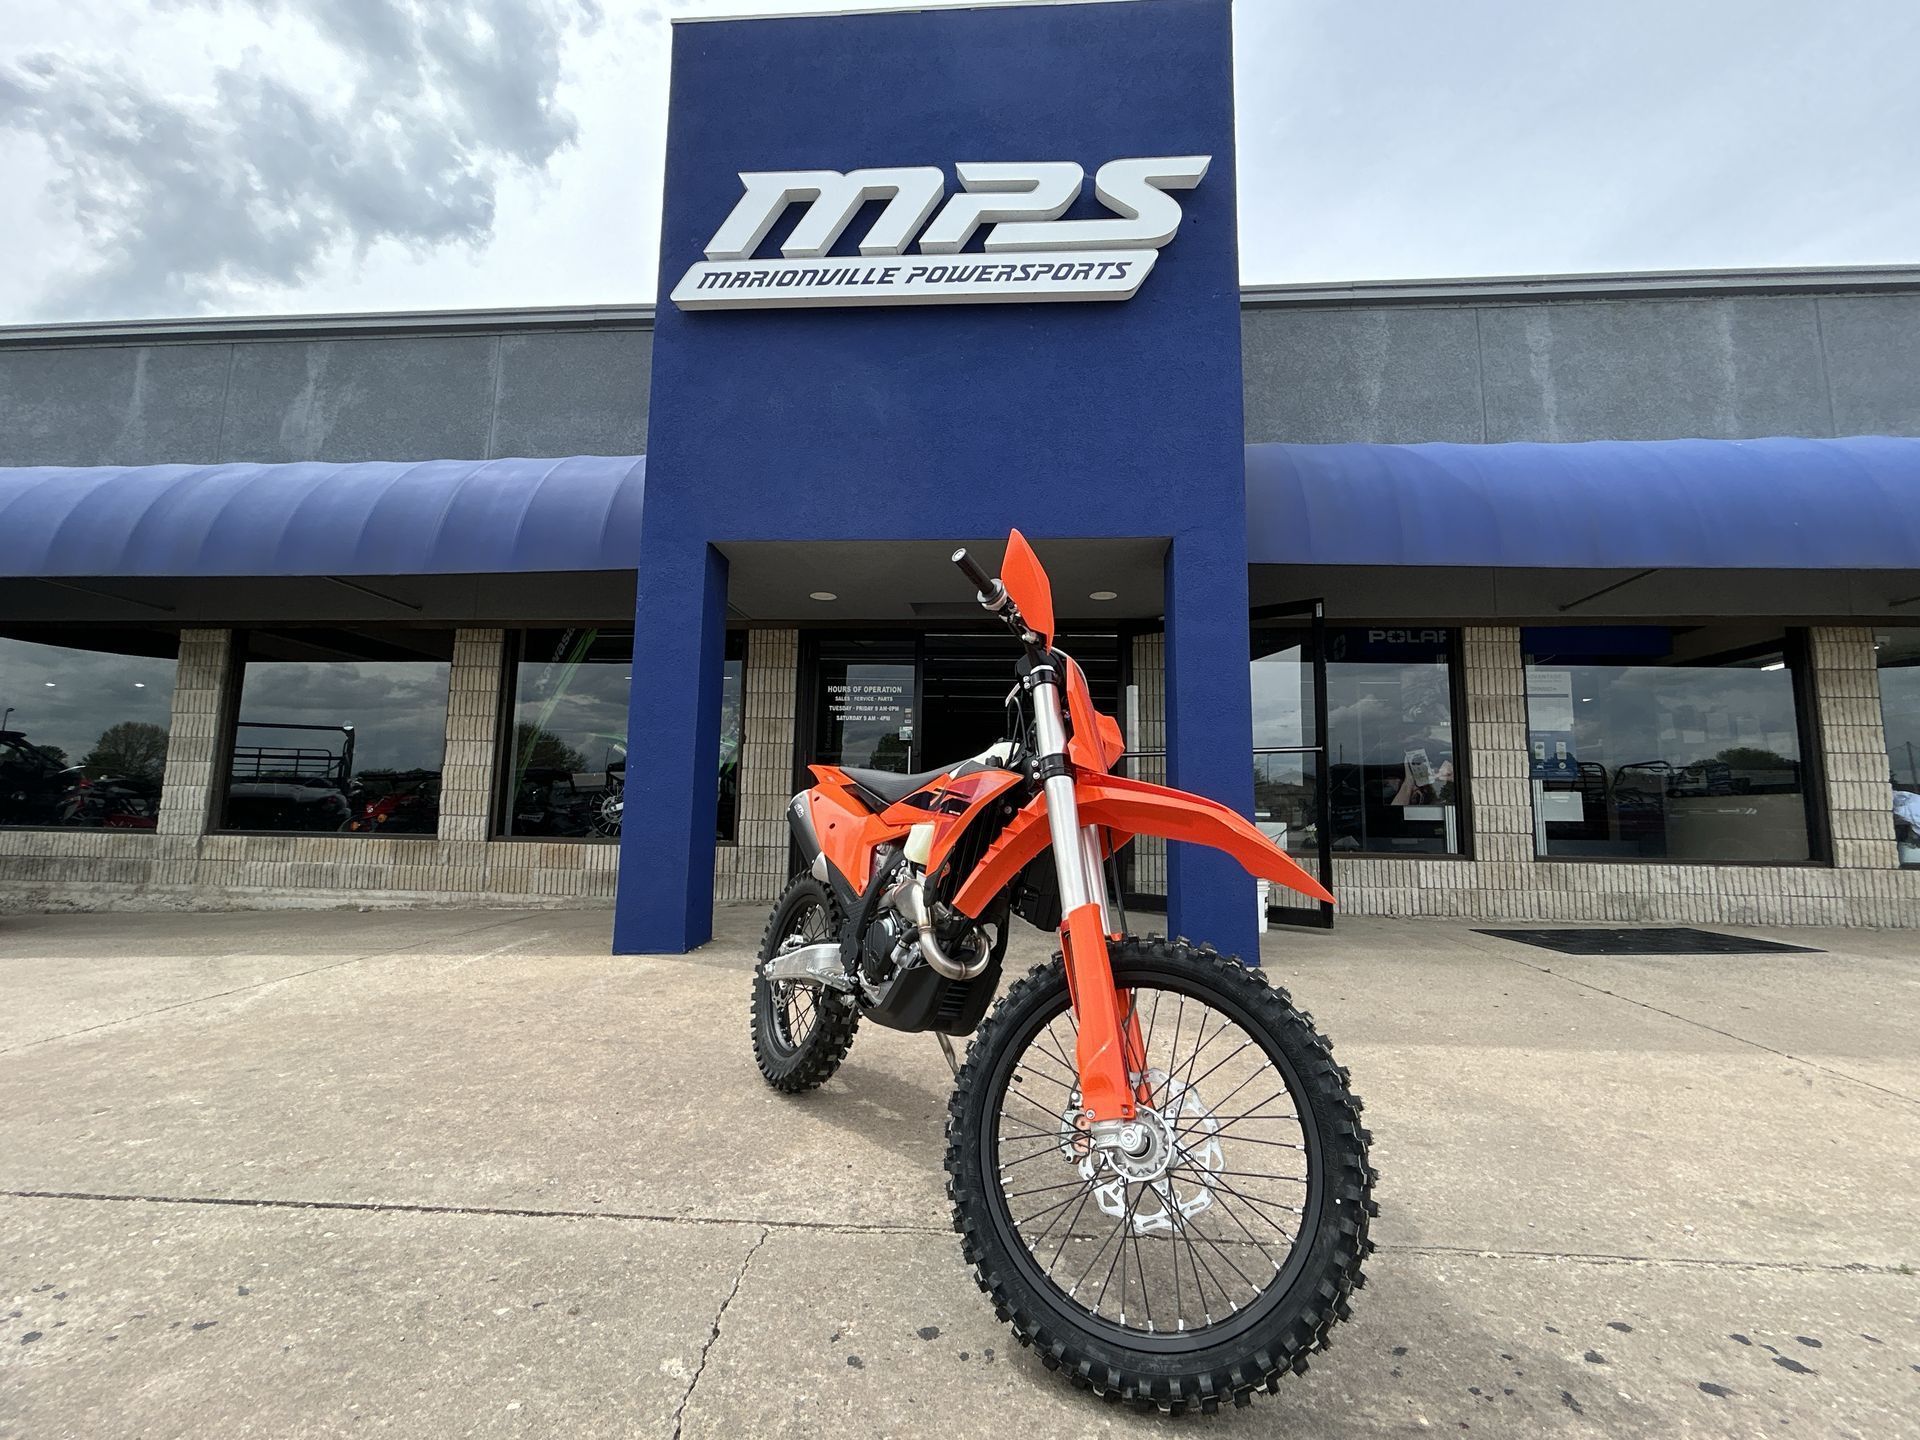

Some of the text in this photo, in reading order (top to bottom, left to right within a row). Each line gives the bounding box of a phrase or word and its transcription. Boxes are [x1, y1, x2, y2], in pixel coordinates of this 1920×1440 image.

[704, 154, 1212, 261] MPS
[697, 260, 1134, 291] MARIONVILLE POWERSPORTS
